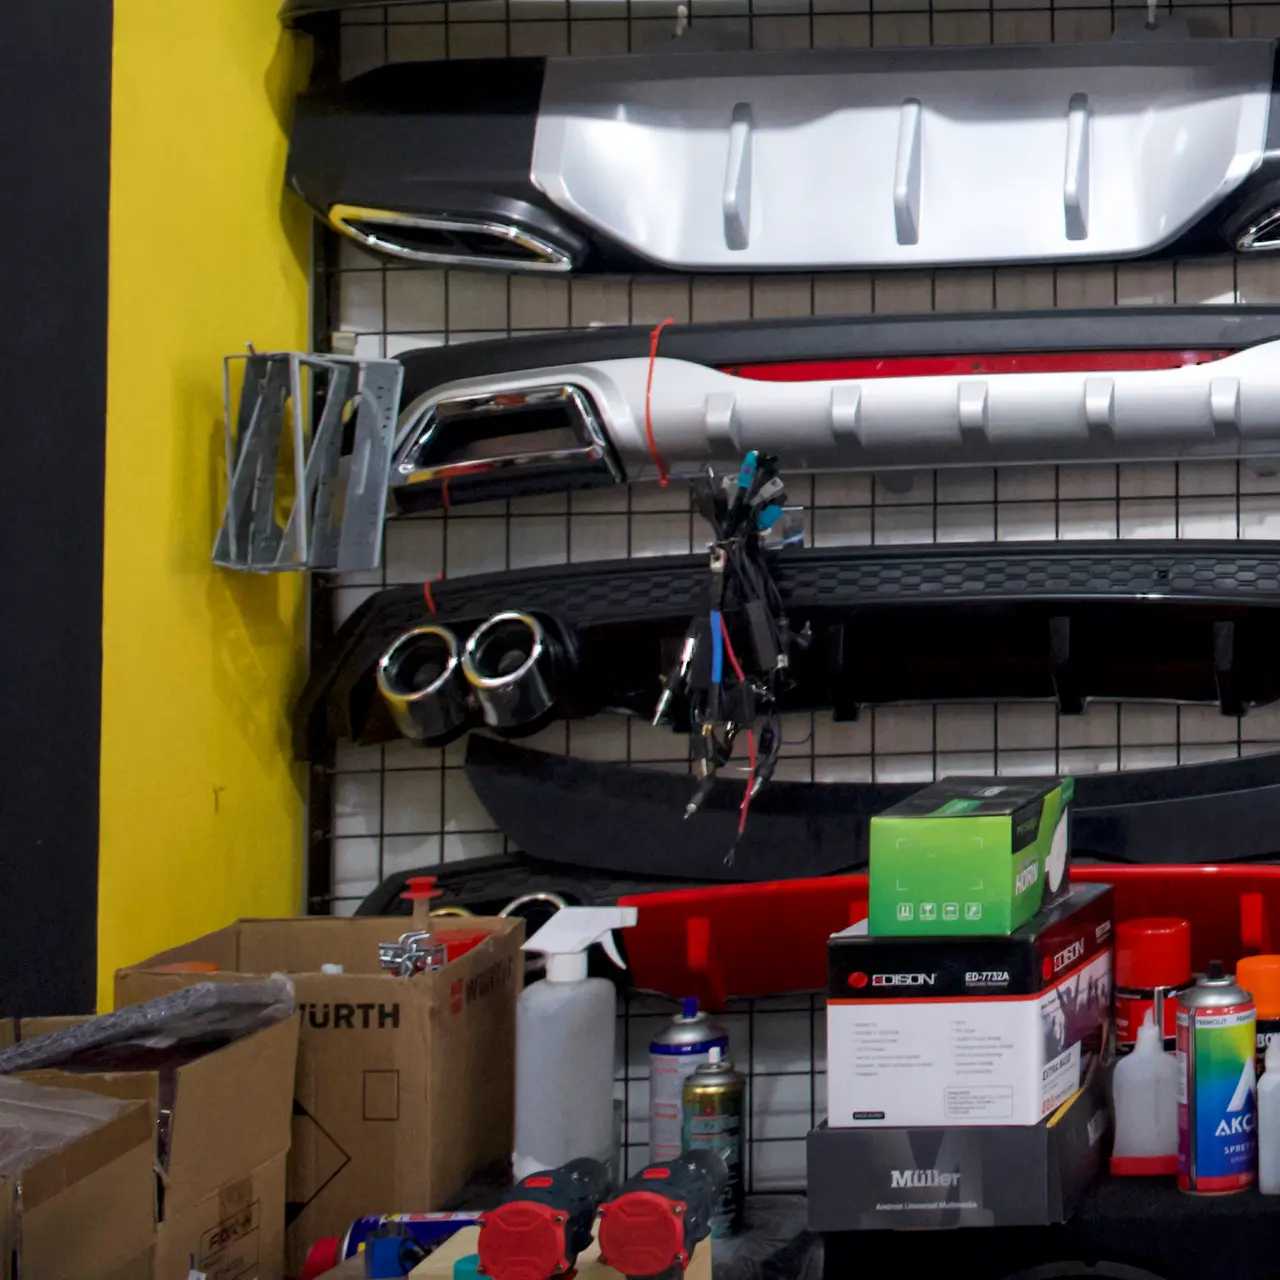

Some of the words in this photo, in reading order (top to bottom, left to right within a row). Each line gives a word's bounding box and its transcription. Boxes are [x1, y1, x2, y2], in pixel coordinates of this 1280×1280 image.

[1015, 860, 1039, 895] HORN
[1053, 936, 1085, 973] EDISON
[872, 973, 935, 986] EDISON
[1214, 1112, 1254, 1136] AKÇ
[890, 1169, 961, 1189] Müller
